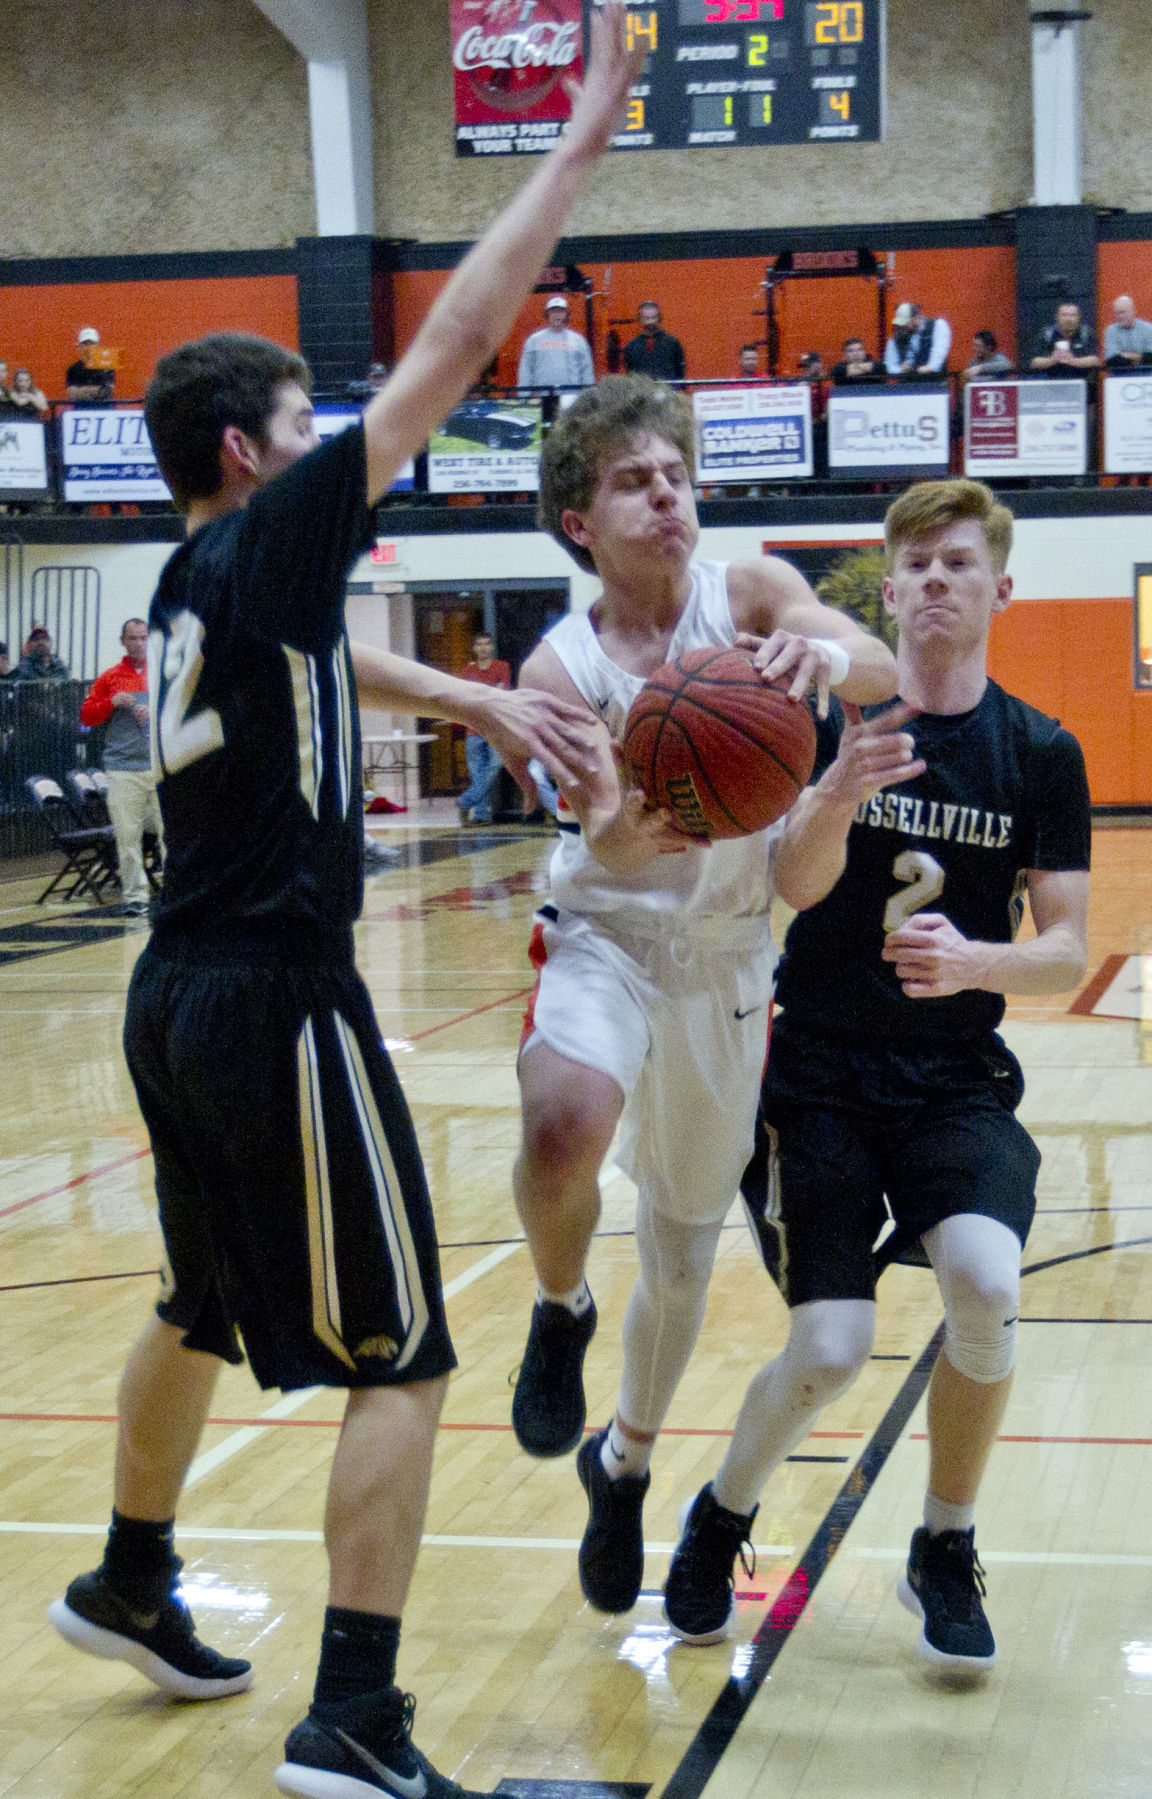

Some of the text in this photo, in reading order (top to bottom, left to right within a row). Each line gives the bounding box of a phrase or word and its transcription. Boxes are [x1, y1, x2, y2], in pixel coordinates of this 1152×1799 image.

[626, 12, 658, 51] 14
[815, 2, 863, 43] 20
[676, 45, 739, 61] PERIOD
[748, 34, 769, 66] 2
[625, 99, 645, 130] 3
[829, 91, 850, 120] 4
[456, 126, 518, 140] ALWAYS
[519, 123, 560, 137] PART
[472, 139, 513, 154] YOUR
[69, 417, 146, 446] ELIT
[854, 793, 1013, 849] USSELLVILLE
[882, 850, 946, 933] 2
